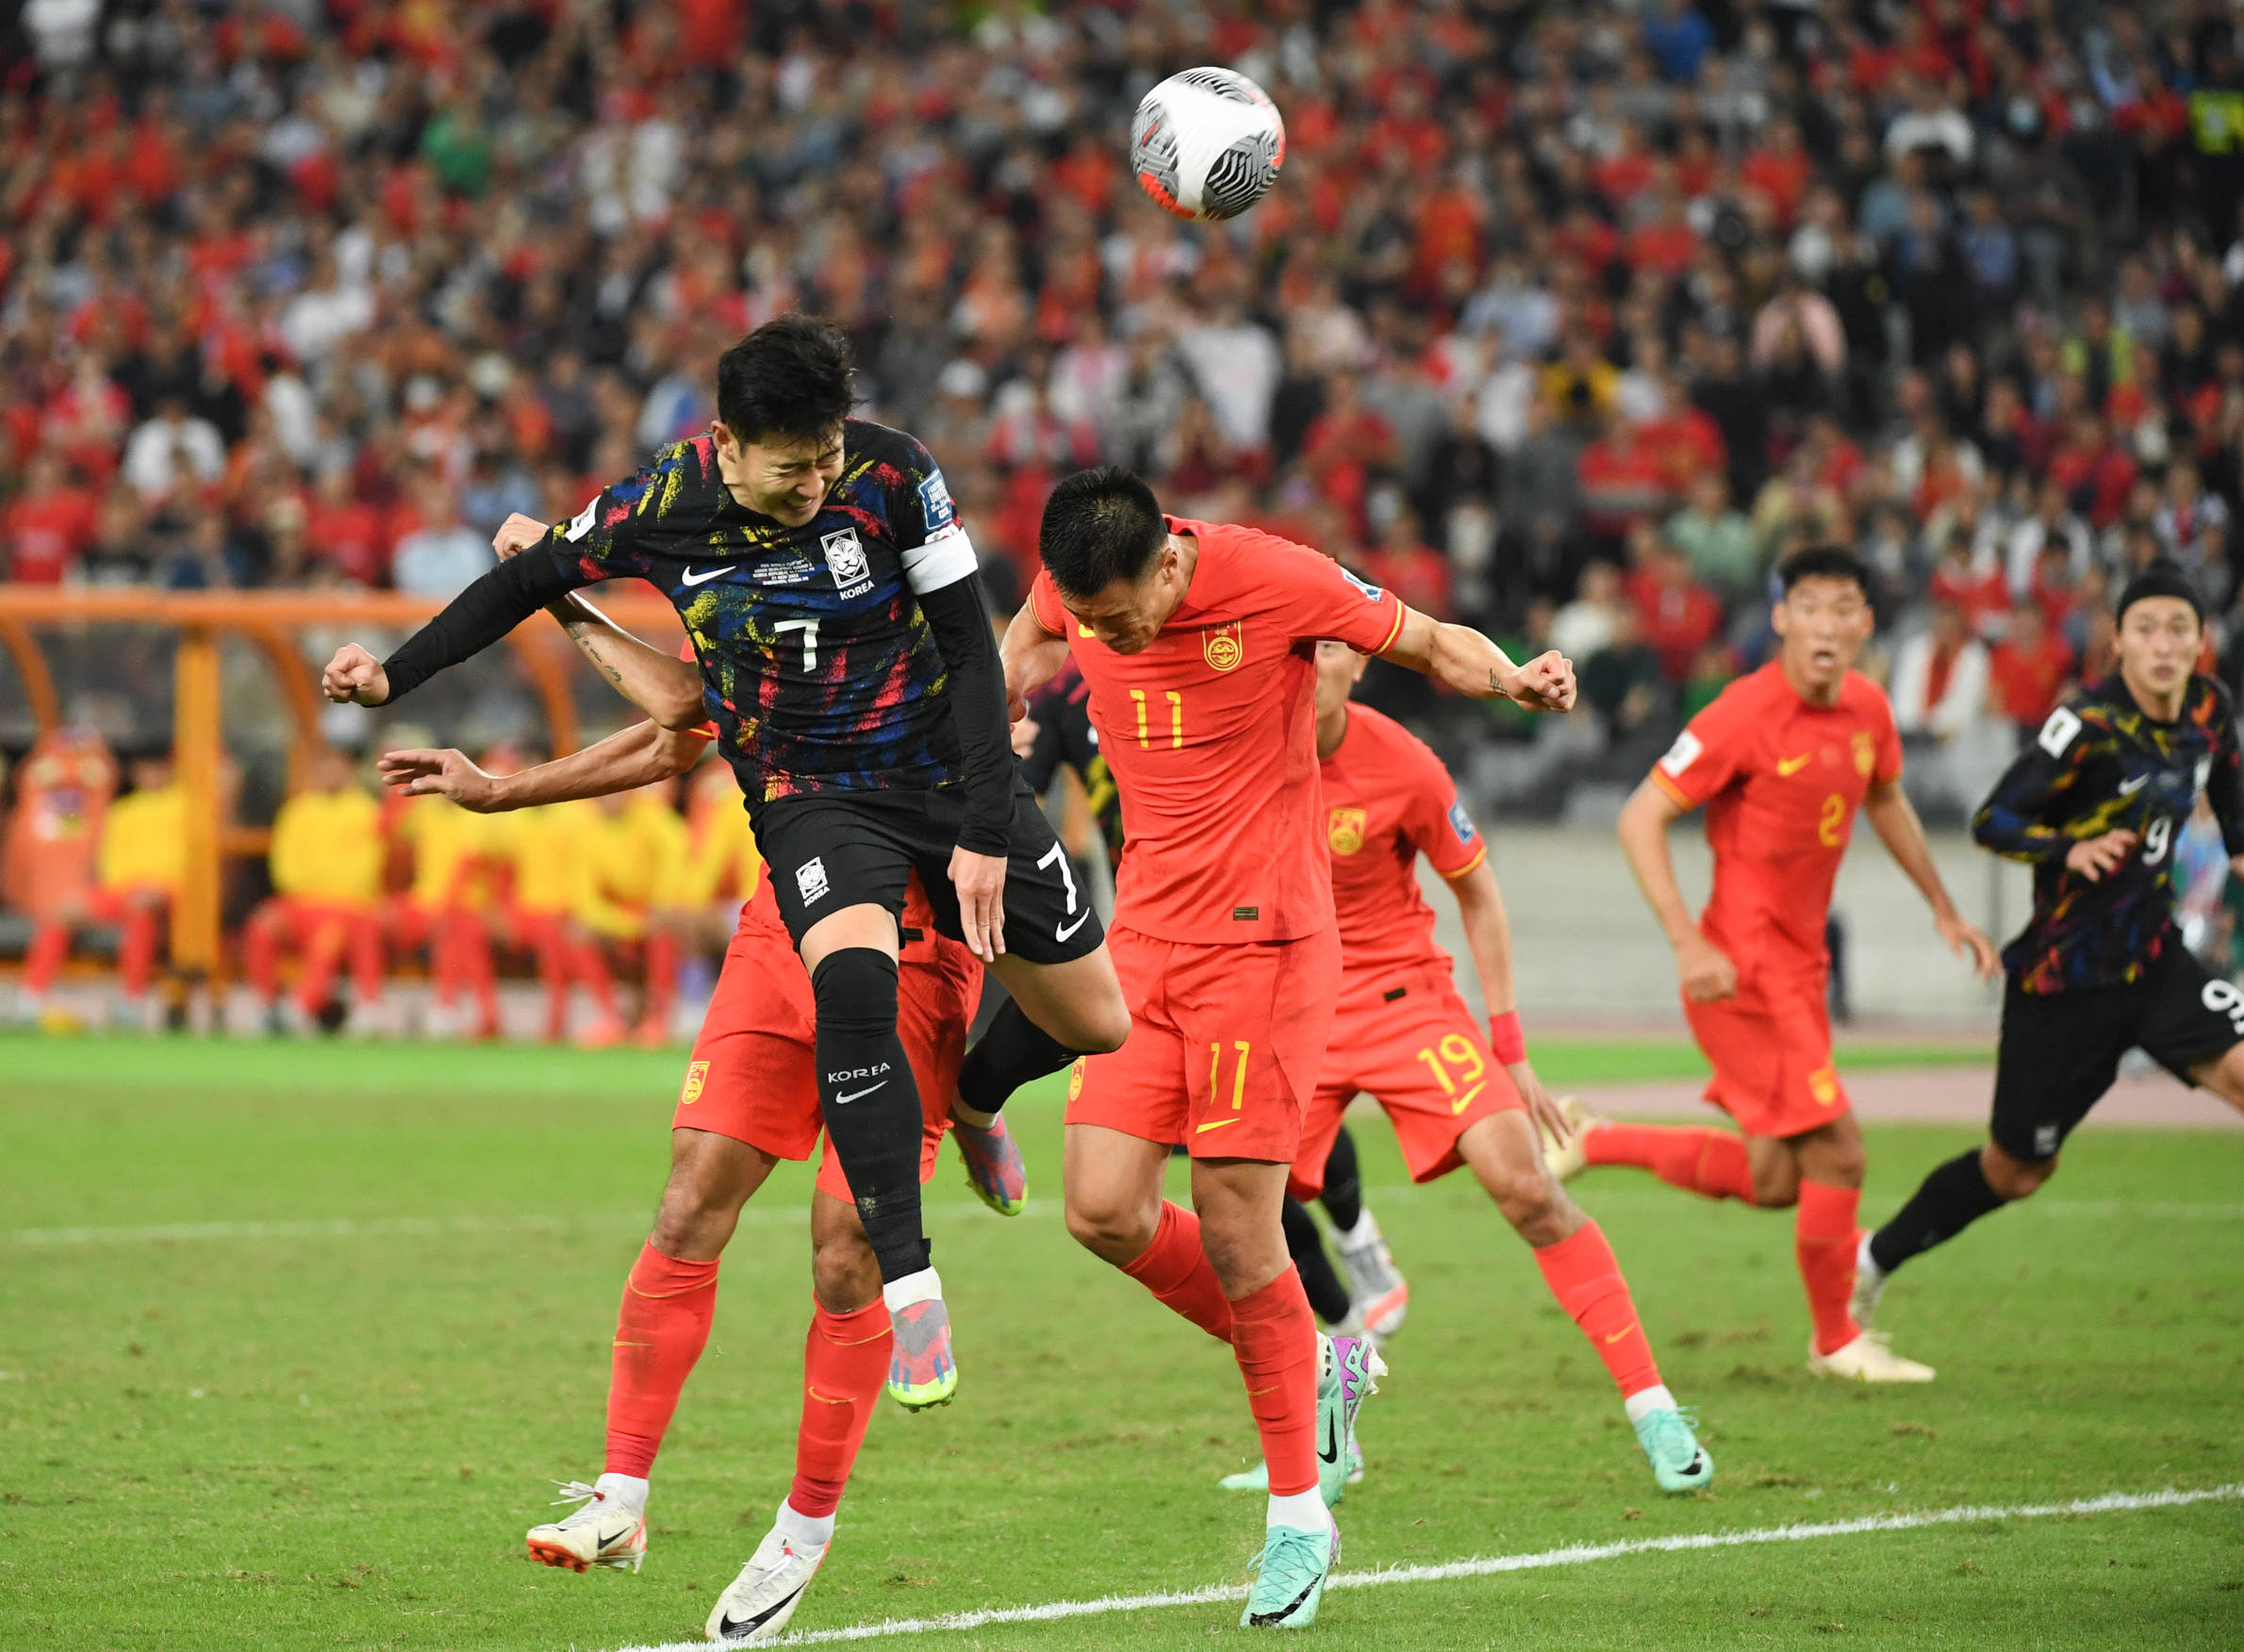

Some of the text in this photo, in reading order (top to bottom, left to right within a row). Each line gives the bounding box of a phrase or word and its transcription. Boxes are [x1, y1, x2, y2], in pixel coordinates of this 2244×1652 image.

[839, 580, 875, 601] KOREA
[774, 619, 820, 672] 7
[1130, 688, 1182, 750] 11
[1819, 792, 1846, 848] 2
[2141, 816, 2172, 866] 9
[804, 886, 830, 907] KOREA
[1037, 840, 1077, 915] 7
[2202, 979, 2244, 1021] 9
[828, 1062, 891, 1083] KOREA
[1210, 1041, 1249, 1109] 11
[1417, 1032, 1484, 1096] 19
